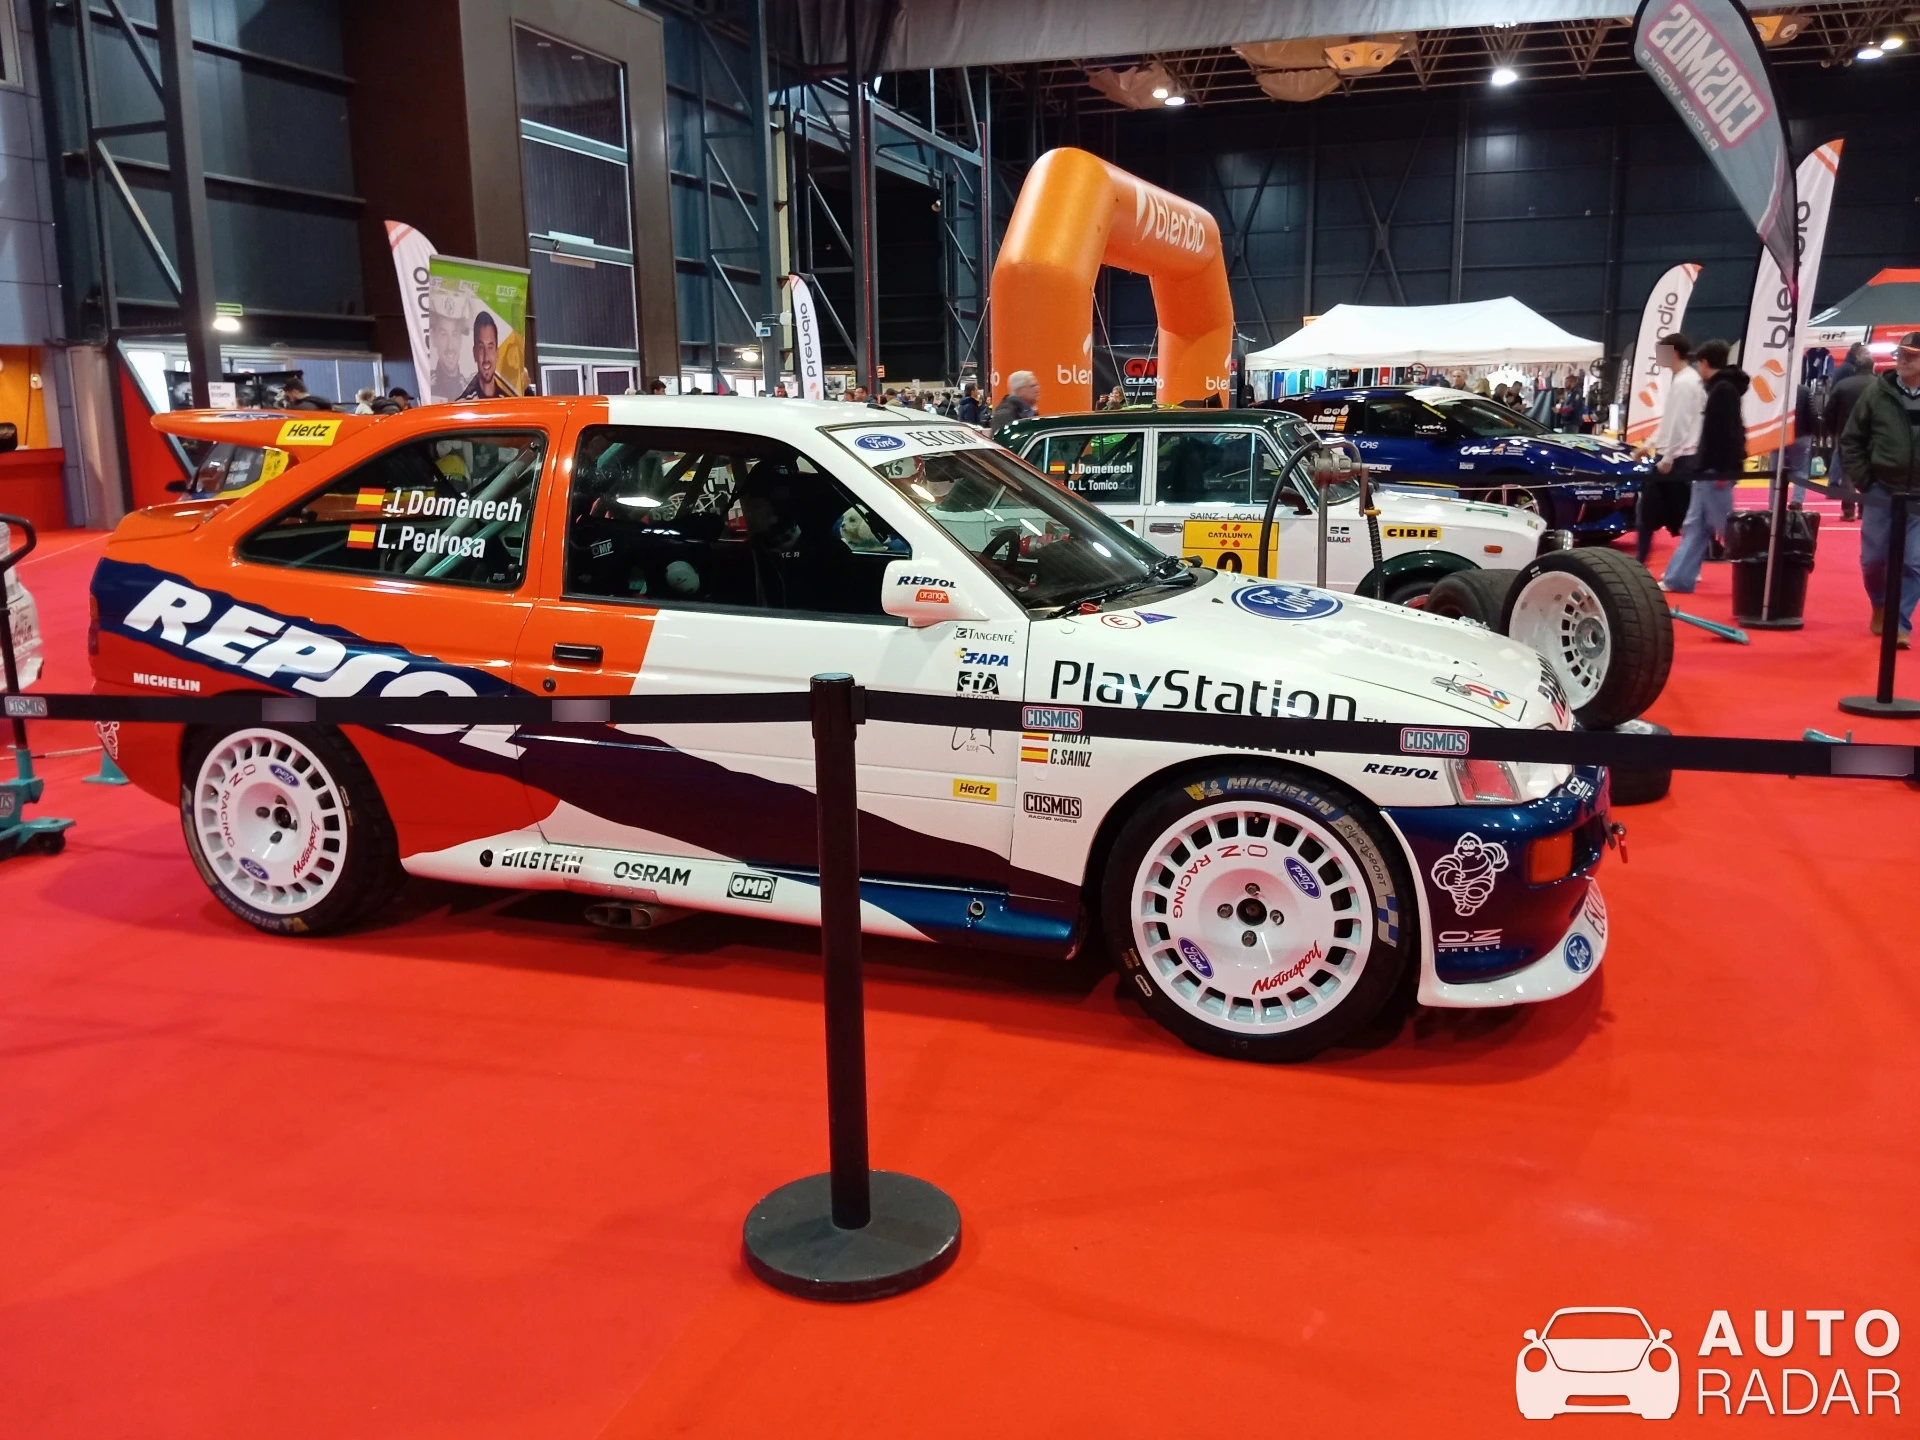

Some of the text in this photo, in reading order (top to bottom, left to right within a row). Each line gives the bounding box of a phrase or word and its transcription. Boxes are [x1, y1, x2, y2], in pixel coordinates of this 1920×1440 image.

[1155, 194, 1205, 253] blendio
[287, 423, 331, 438] Hertz
[863, 436, 898, 449] Ford
[1088, 479, 1119, 491] Tomico
[1189, 512, 1219, 521] SAINZ
[1208, 531, 1253, 539] CATALUNYA
[592, 542, 613, 554] OMP
[896, 575, 957, 589] REPSOL
[919, 591, 948, 602] orange
[968, 628, 1015, 643] TANGENTE
[133, 672, 201, 691] MICHELIN
[1050, 660, 1358, 721] PlayStation
[1025, 709, 1080, 729] COSMOS
[1403, 729, 1467, 752] COSMOS
[1050, 749, 1092, 768] C.SAINZ
[1363, 763, 1439, 780] REPSOL
[959, 782, 991, 796] Hertz
[1226, 776, 1337, 817] MICHELIN
[1025, 793, 1080, 817] COSMOS
[1028, 813, 1052, 821] RACING
[501, 848, 584, 874] BILSTEIN
[613, 860, 692, 887] OSRAM
[1172, 854, 1212, 919] RACING
[1251, 938, 1323, 996] Motorsport
